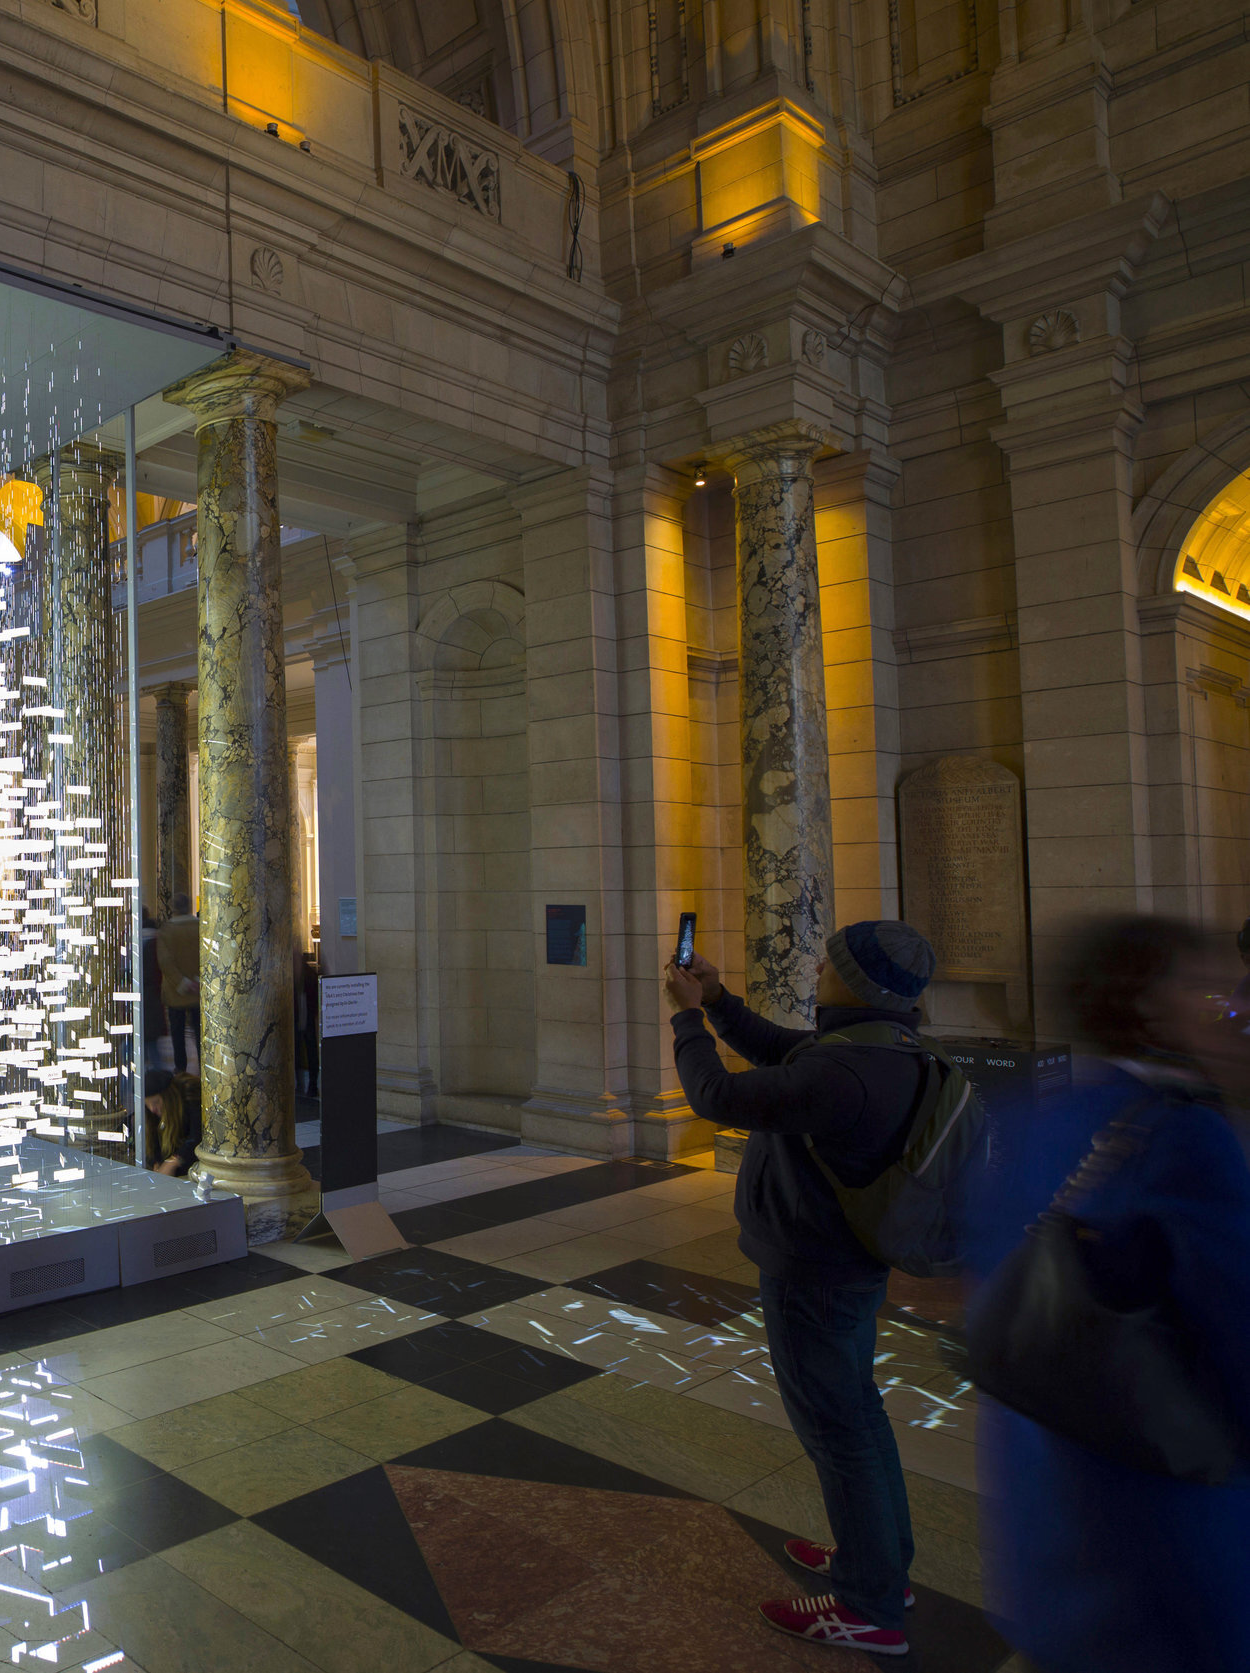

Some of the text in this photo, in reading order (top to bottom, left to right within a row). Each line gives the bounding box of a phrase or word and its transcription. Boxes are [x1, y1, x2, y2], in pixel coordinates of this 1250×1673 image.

[952, 787, 973, 796] AND
[975, 785, 1013, 795] ALBERT
[934, 795, 981, 804] MUSEUM
[961, 818, 1002, 826] COUNTRY
[975, 825, 999, 833] KING
[981, 831, 998, 839] SEA
[950, 1055, 1016, 1068] YOUR WORD
